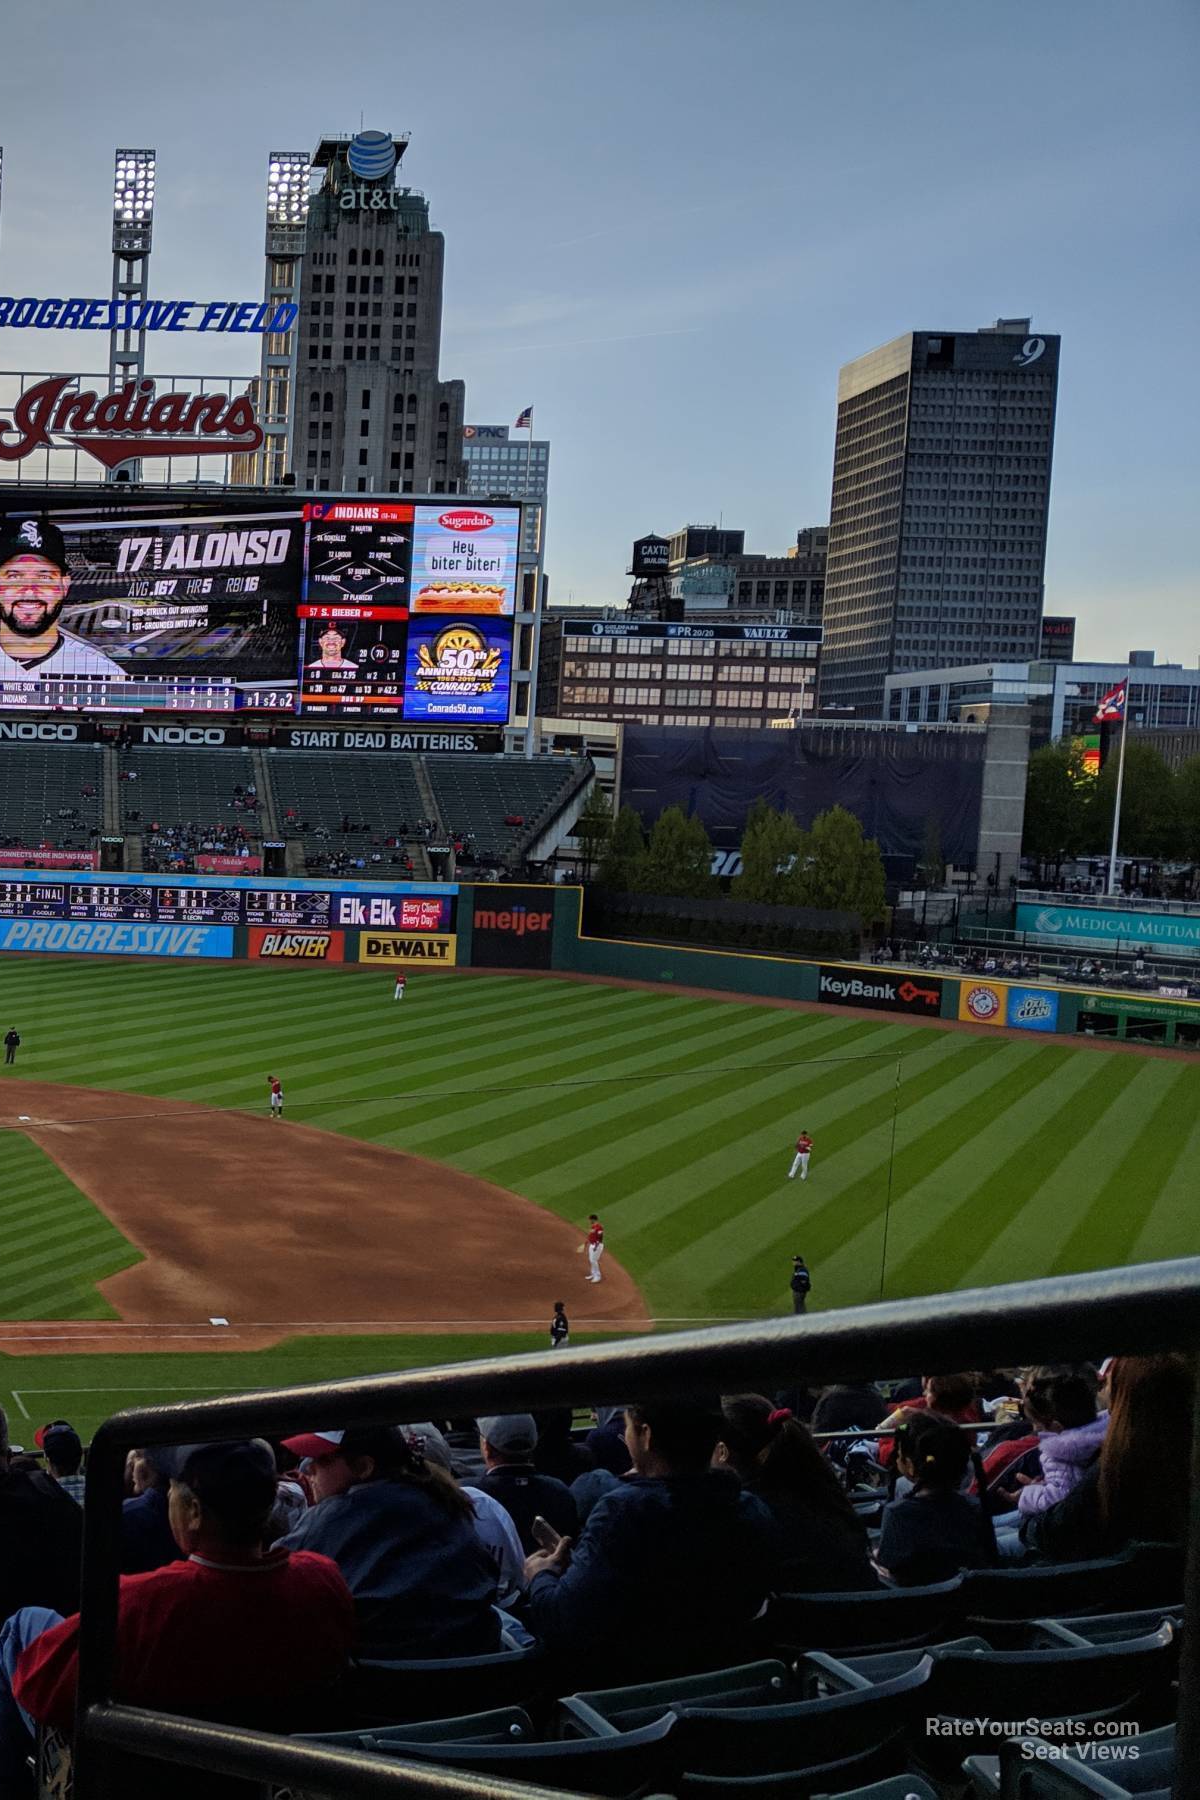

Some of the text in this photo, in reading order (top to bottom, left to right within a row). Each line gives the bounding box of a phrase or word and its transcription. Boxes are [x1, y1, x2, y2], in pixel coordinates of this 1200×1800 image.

[339, 184, 398, 211] at&t
[200, 301, 298, 333] FIELD
[1019, 338, 1046, 367] 9
[477, 427, 505, 438] PNC
[335, 507, 379, 518] INDIANS
[442, 515, 492, 528] Sugardale
[117, 538, 152, 572] 17
[163, 529, 291, 570] ALONSO
[453, 541, 477, 556] Hey,
[431, 556, 500, 571] biter biter!
[128, 576, 260, 597] AVG .167 HR 5 RBI 16
[168, 606, 179, 615] OUT
[310, 608, 360, 617] 57 S. BIEBER
[678, 627, 714, 637] PR 20/20
[744, 628, 788, 638] VAULTZ
[360, 649, 367, 657] 20
[440, 649, 487, 669] 50th
[343, 671, 356, 679] 2.95
[416, 668, 497, 677] ANNIVERSARY
[2, 683, 22, 691] WHITE
[384, 686, 397, 694] 42.2
[430, 682, 480, 691] CONRAD'S
[2, 695, 27, 704] INDIANS
[428, 704, 484, 714] Conrads50.com
[142, 727, 226, 744] NOCO
[290, 731, 479, 751] START DEAD BATTERIES.
[36, 889, 61, 900] FINAL
[339, 898, 396, 926] Elk Elk
[402, 901, 421, 915] Every
[402, 914, 419, 928] Every
[474, 906, 551, 937] meijer
[1066, 916, 1132, 932] MEDICAL
[2, 921, 210, 954] PROGRESSIVE
[259, 933, 330, 958] BLASTER
[820, 975, 896, 1000] KeyBank
[1018, 1007, 1049, 1017] CLEAN
